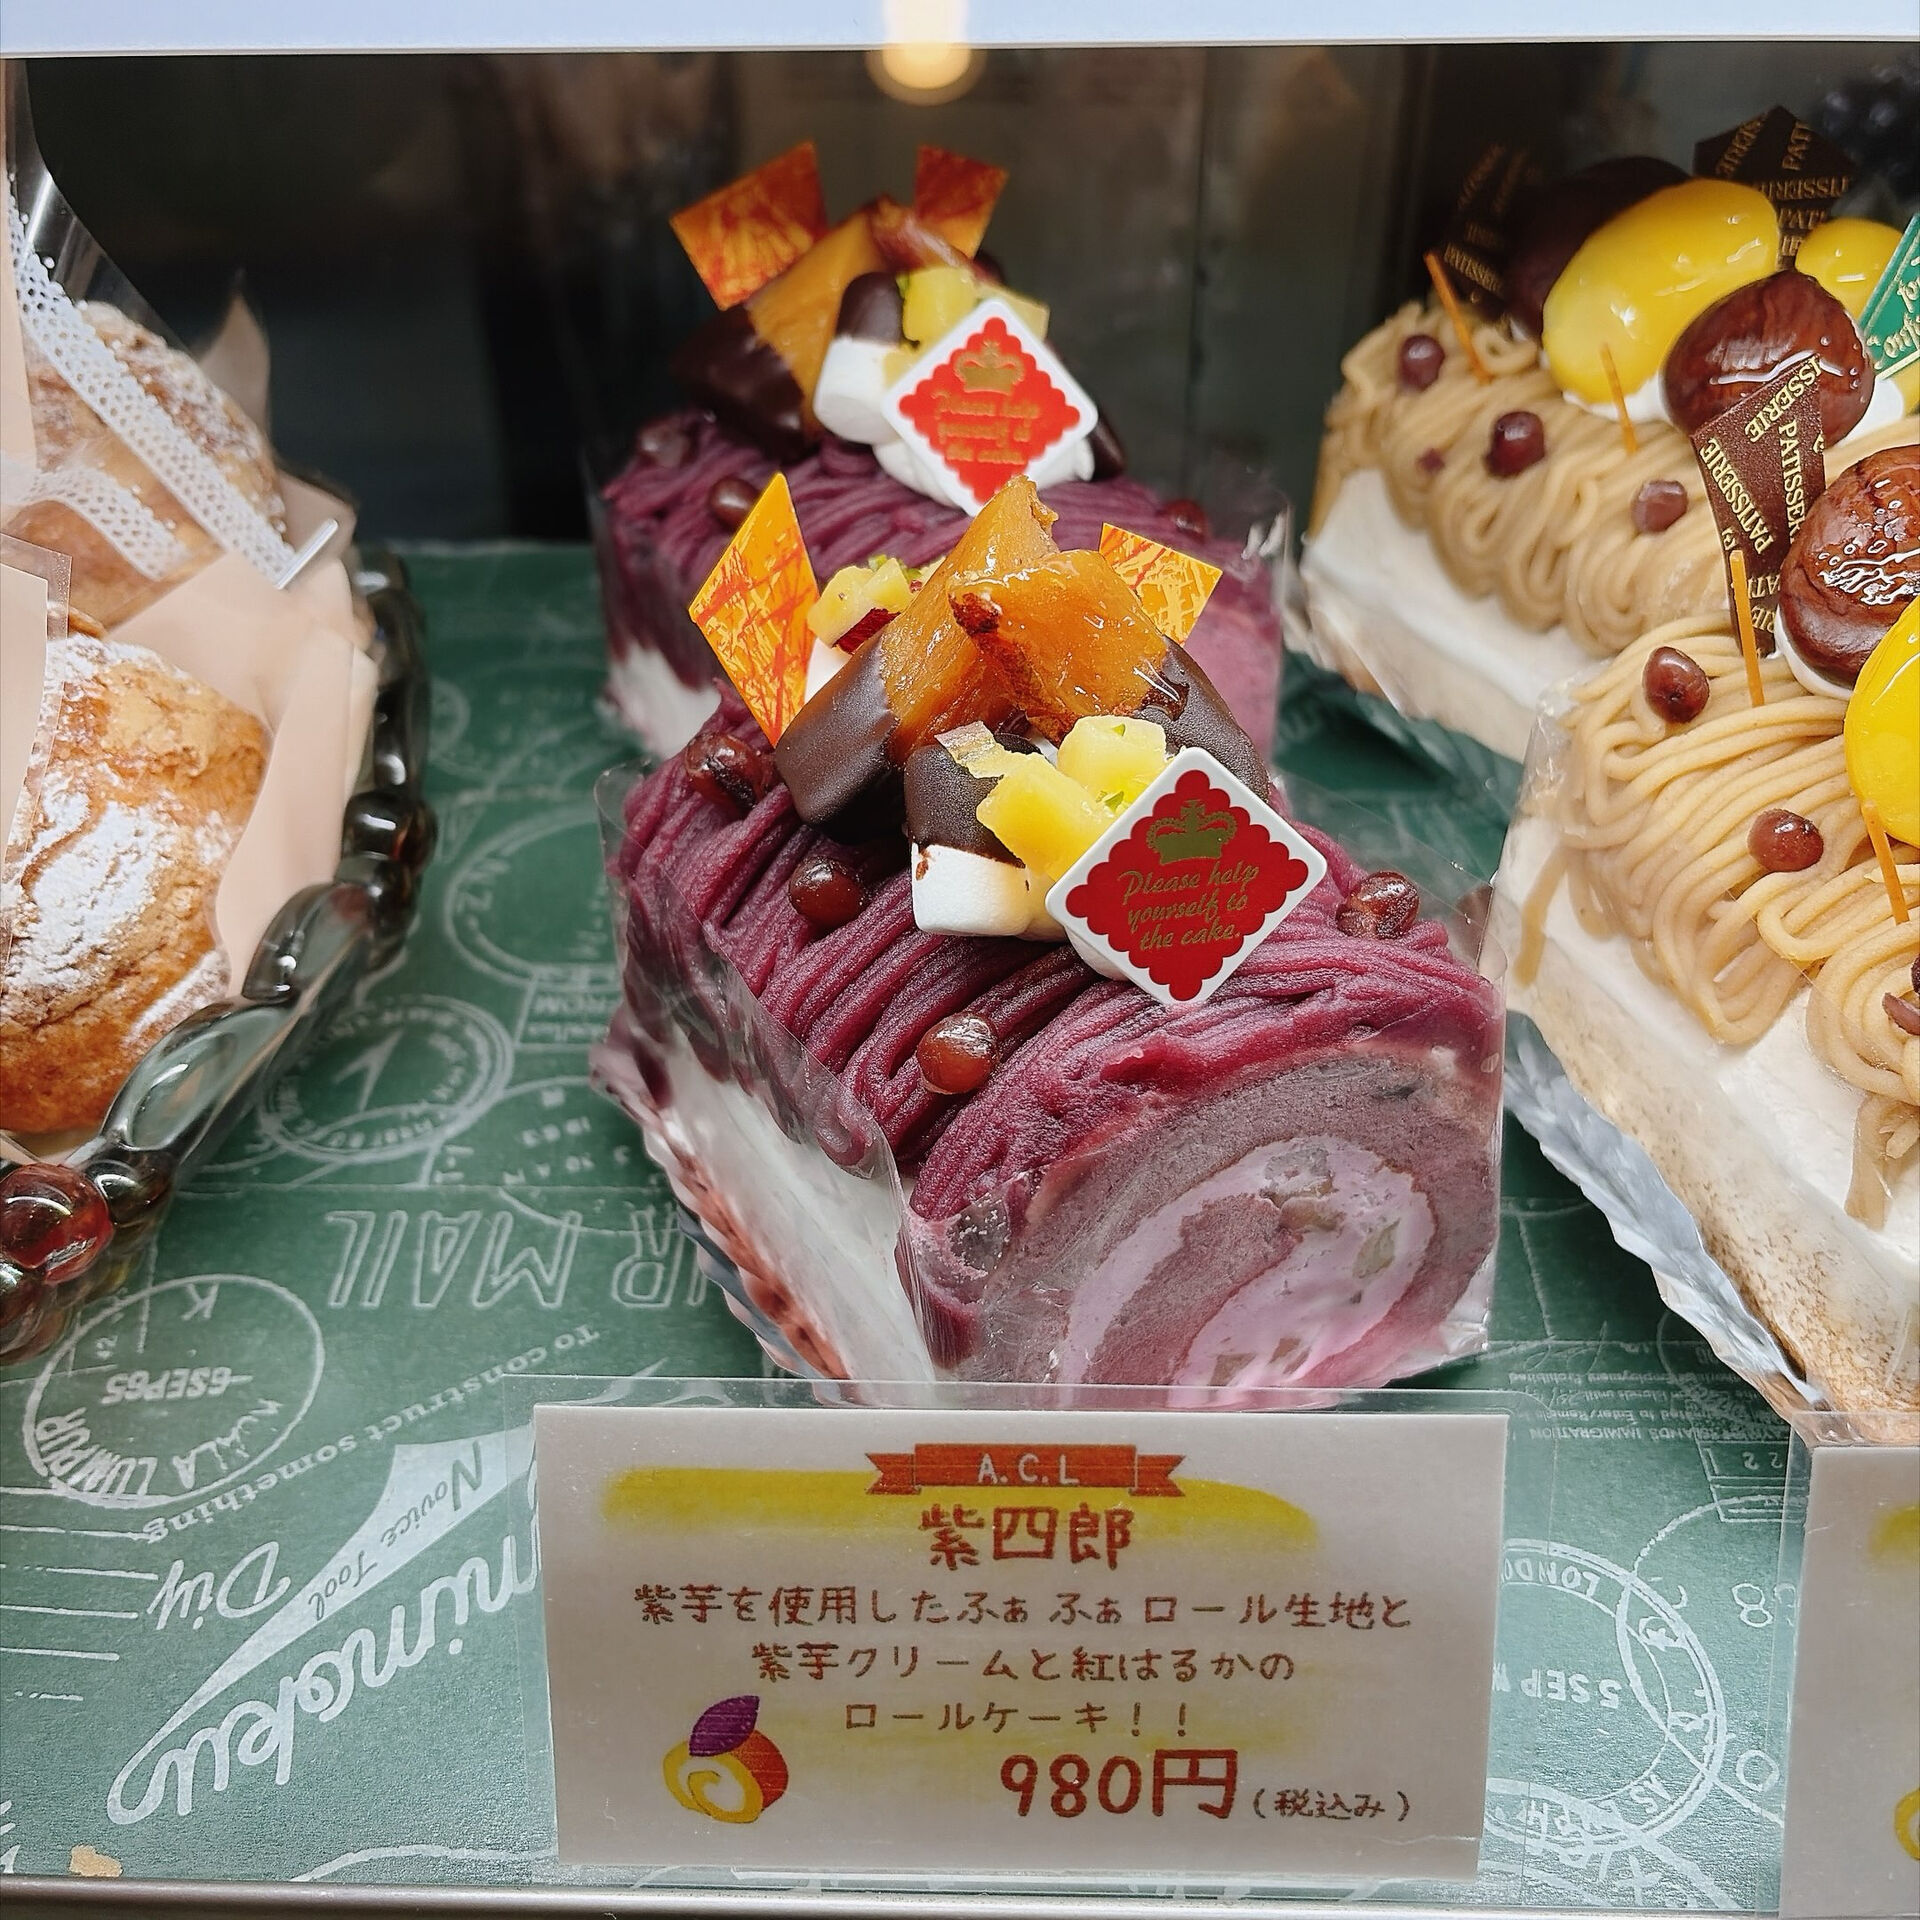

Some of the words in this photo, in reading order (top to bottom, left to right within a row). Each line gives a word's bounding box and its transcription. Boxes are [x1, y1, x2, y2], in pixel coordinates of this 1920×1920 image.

[1700, 437, 1775, 555] PATISSERIE
[1117, 870, 1201, 905] Please
[1207, 860, 1260, 892] help
[1127, 887, 1220, 933] yourself
[1226, 892, 1248, 912] to
[1139, 922, 1173, 950] the
[1181, 916, 1241, 945] cake.
[325, 1209, 583, 1310] MAIL
[554, 1323, 601, 1351] To
[362, 1345, 548, 1442] construct
[1529, 1426, 1641, 1440] IMMIGRATION
[143, 1433, 358, 1545] something
[381, 1440, 484, 1549] Novice
[977, 1452, 1080, 1486] A.C.L
[918, 1502, 1136, 1571] 紫四郎
[147, 1541, 292, 1631] Diy
[306, 1550, 378, 1621] Tool
[751, 1641, 1296, 1683] 紫芋クリームと紅はるかの
[1000, 1748, 1238, 1819] 980円
